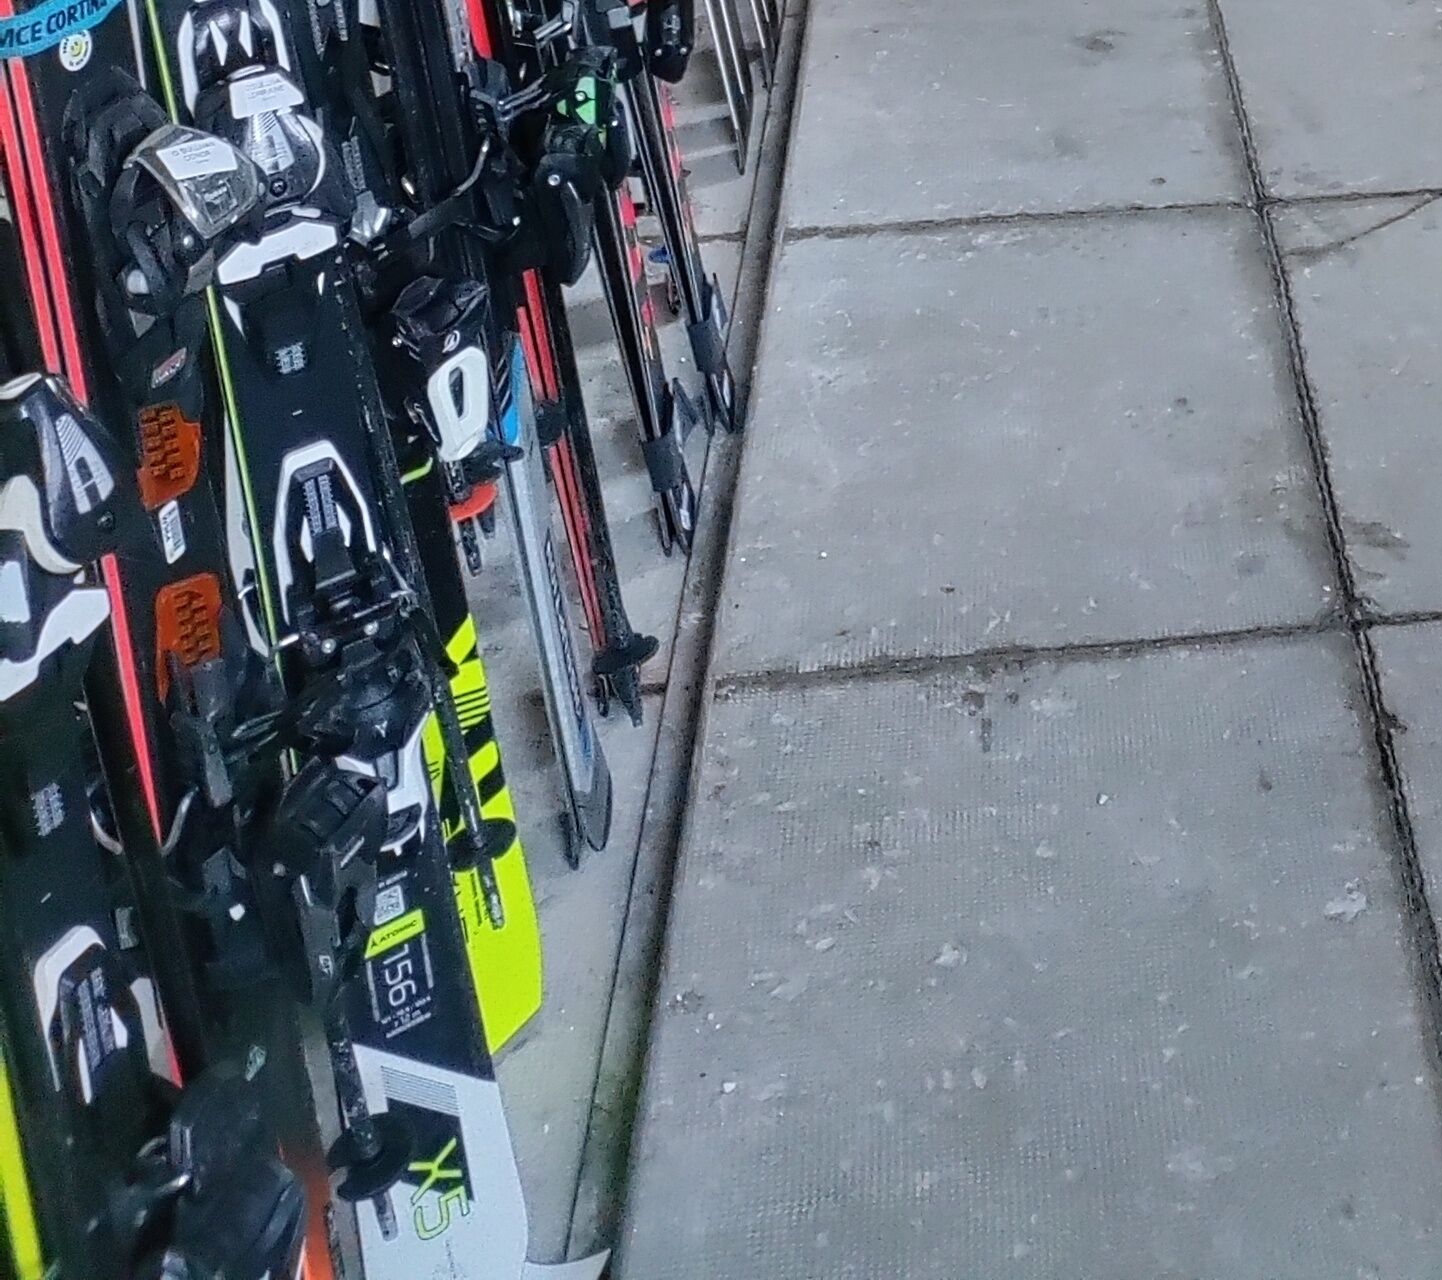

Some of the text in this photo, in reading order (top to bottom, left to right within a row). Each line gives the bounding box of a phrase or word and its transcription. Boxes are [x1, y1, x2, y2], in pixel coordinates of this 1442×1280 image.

[379, 919, 418, 943] ATOMIC
[382, 943, 417, 1008] 156
[407, 1137, 471, 1240] X5
